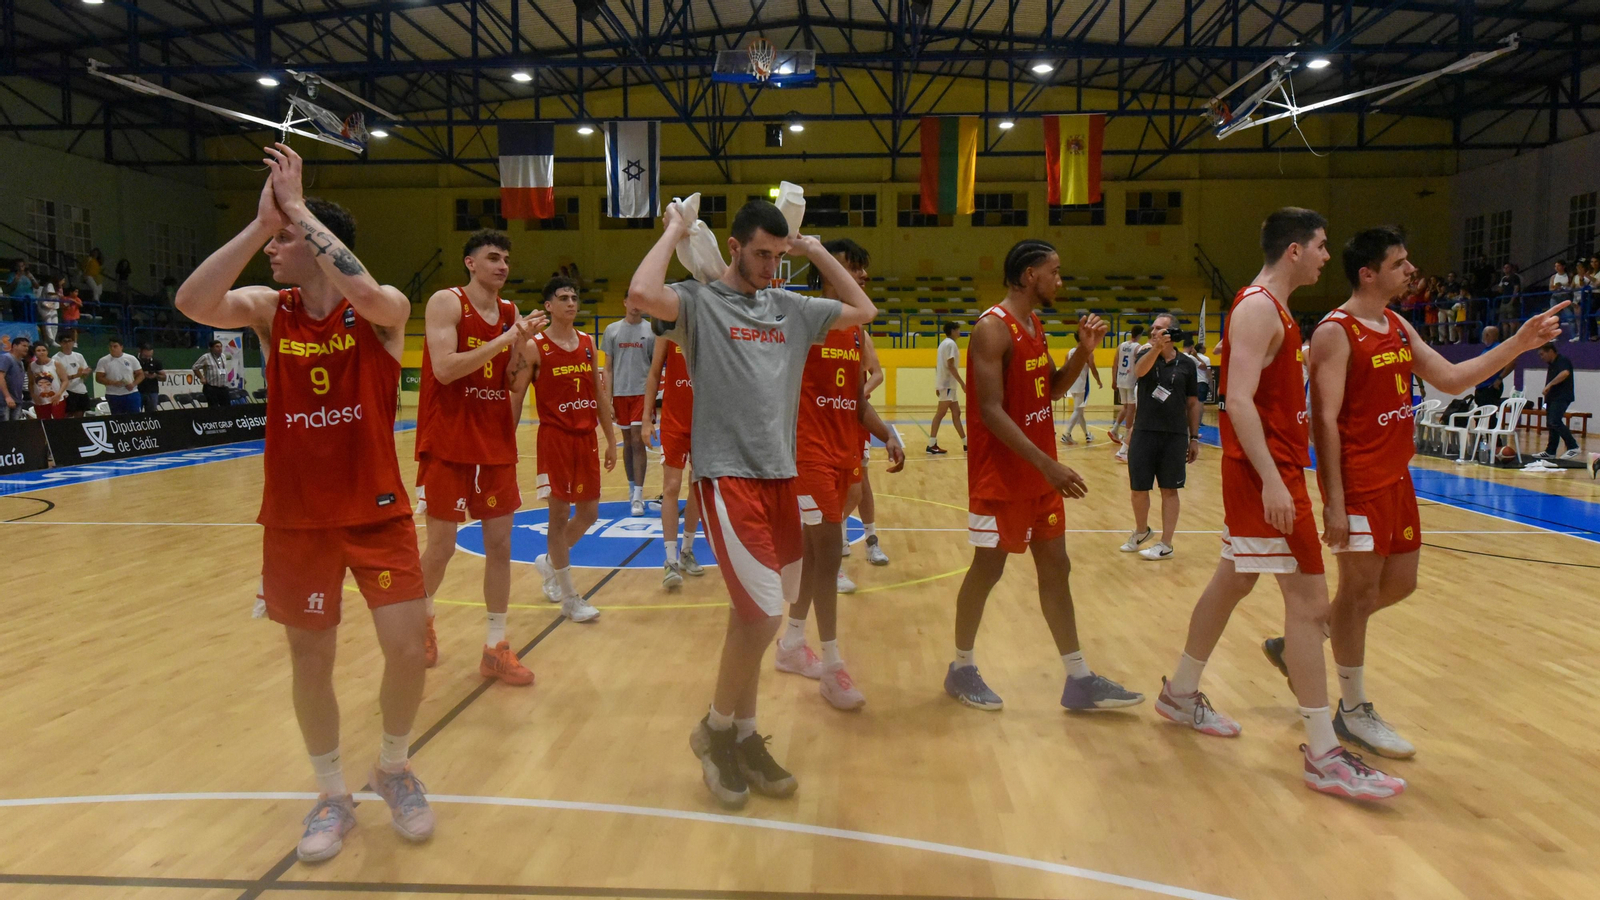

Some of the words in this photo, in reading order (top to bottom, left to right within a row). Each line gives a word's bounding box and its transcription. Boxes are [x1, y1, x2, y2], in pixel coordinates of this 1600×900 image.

[730, 327, 786, 343] ESPAÑA
[279, 333, 356, 357] ESPAÑA
[821, 347, 860, 361] ESPAÑA
[1122, 355, 1129, 367] 5
[552, 362, 592, 376] ESPAÑA
[310, 367, 330, 394] 9
[836, 367, 845, 387] 6
[573, 378, 580, 392] 7
[558, 398, 597, 412] endea
[816, 395, 857, 410] endea
[109, 417, 161, 435] Diputación
[202, 421, 217, 430] PONT
[218, 420, 233, 429] GRUP
[117, 439, 130, 453] de
[132, 435, 159, 450] Cádiz
[308, 592, 324, 609] fi
